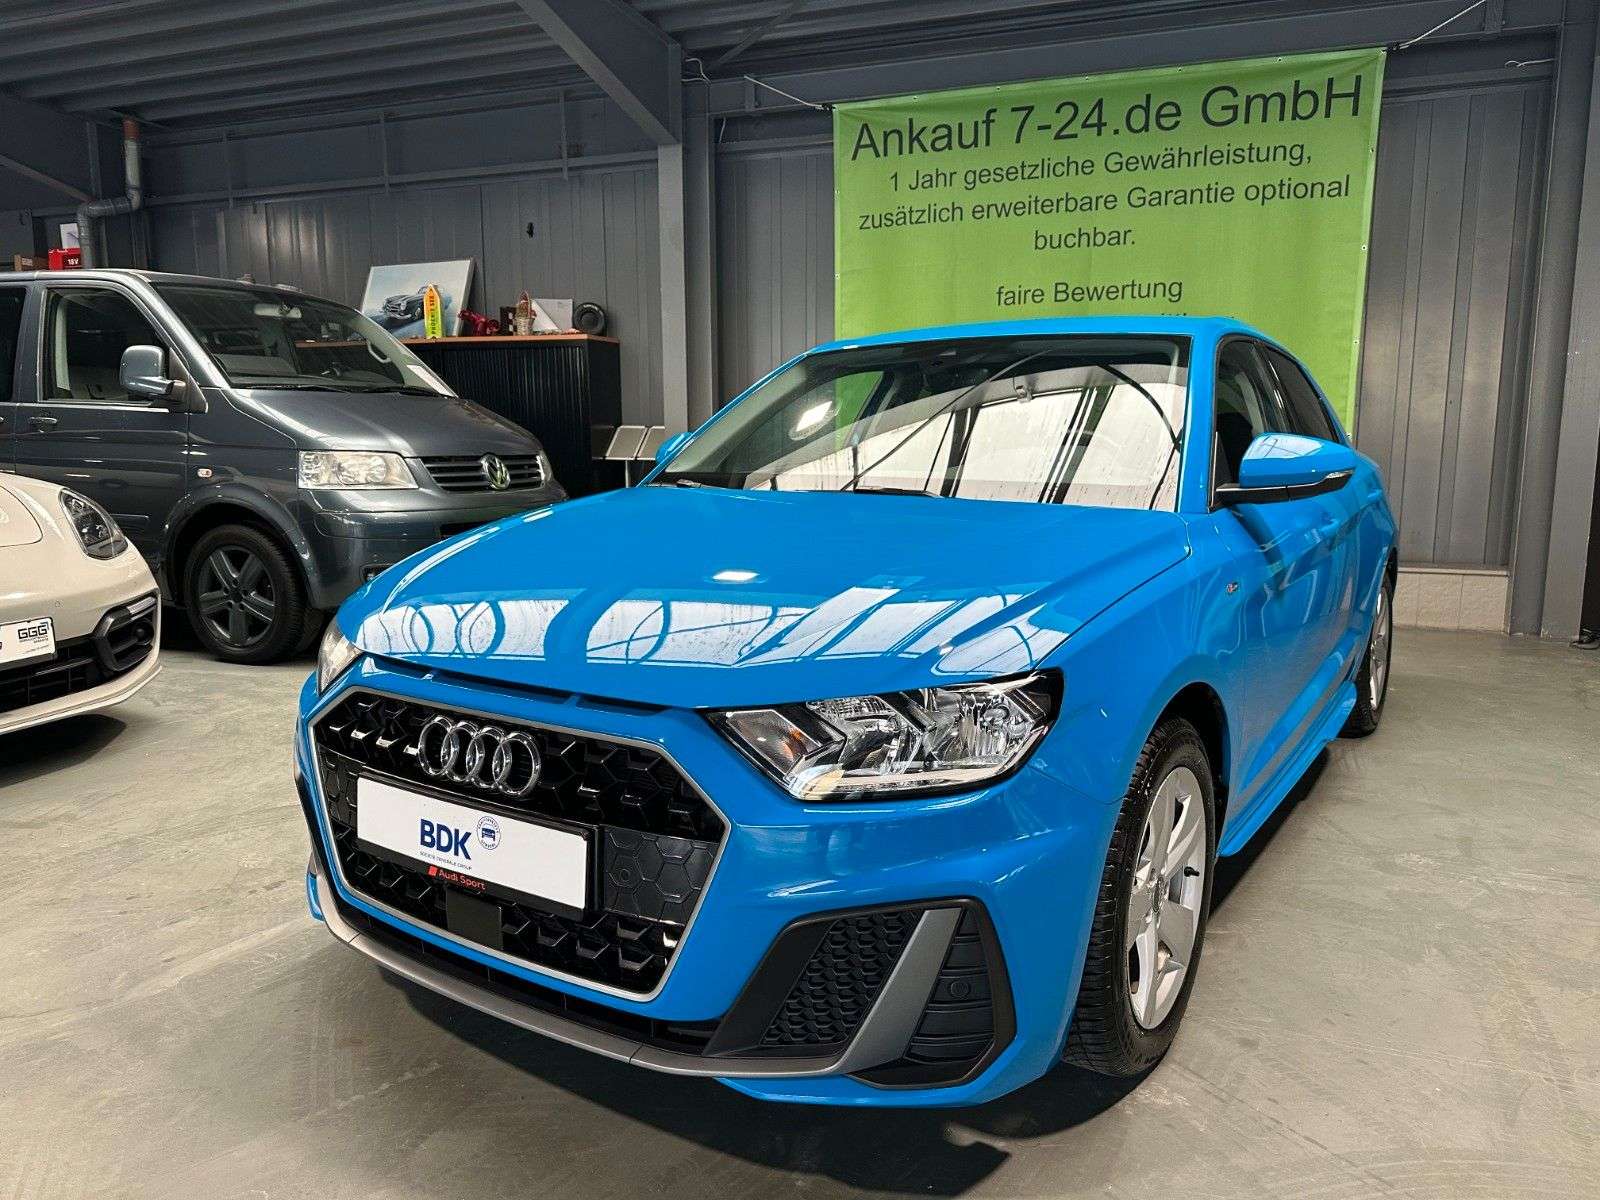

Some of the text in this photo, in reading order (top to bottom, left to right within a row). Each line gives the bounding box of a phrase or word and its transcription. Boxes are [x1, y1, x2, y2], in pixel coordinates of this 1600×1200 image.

[851, 74, 1363, 161] Ankauf 7-24.de GmbH
[890, 142, 1312, 192] 1 Jahr gesetzliche Gewährleistung,
[859, 174, 1350, 230] zusätzlich erweiterbare Garantie optional
[1034, 226, 1136, 251] buchbar.
[996, 279, 1183, 306] faire Bewertung
[18, 624, 48, 639] GGG
[420, 818, 472, 860] BDK
[438, 869, 486, 890] Audi Sport
